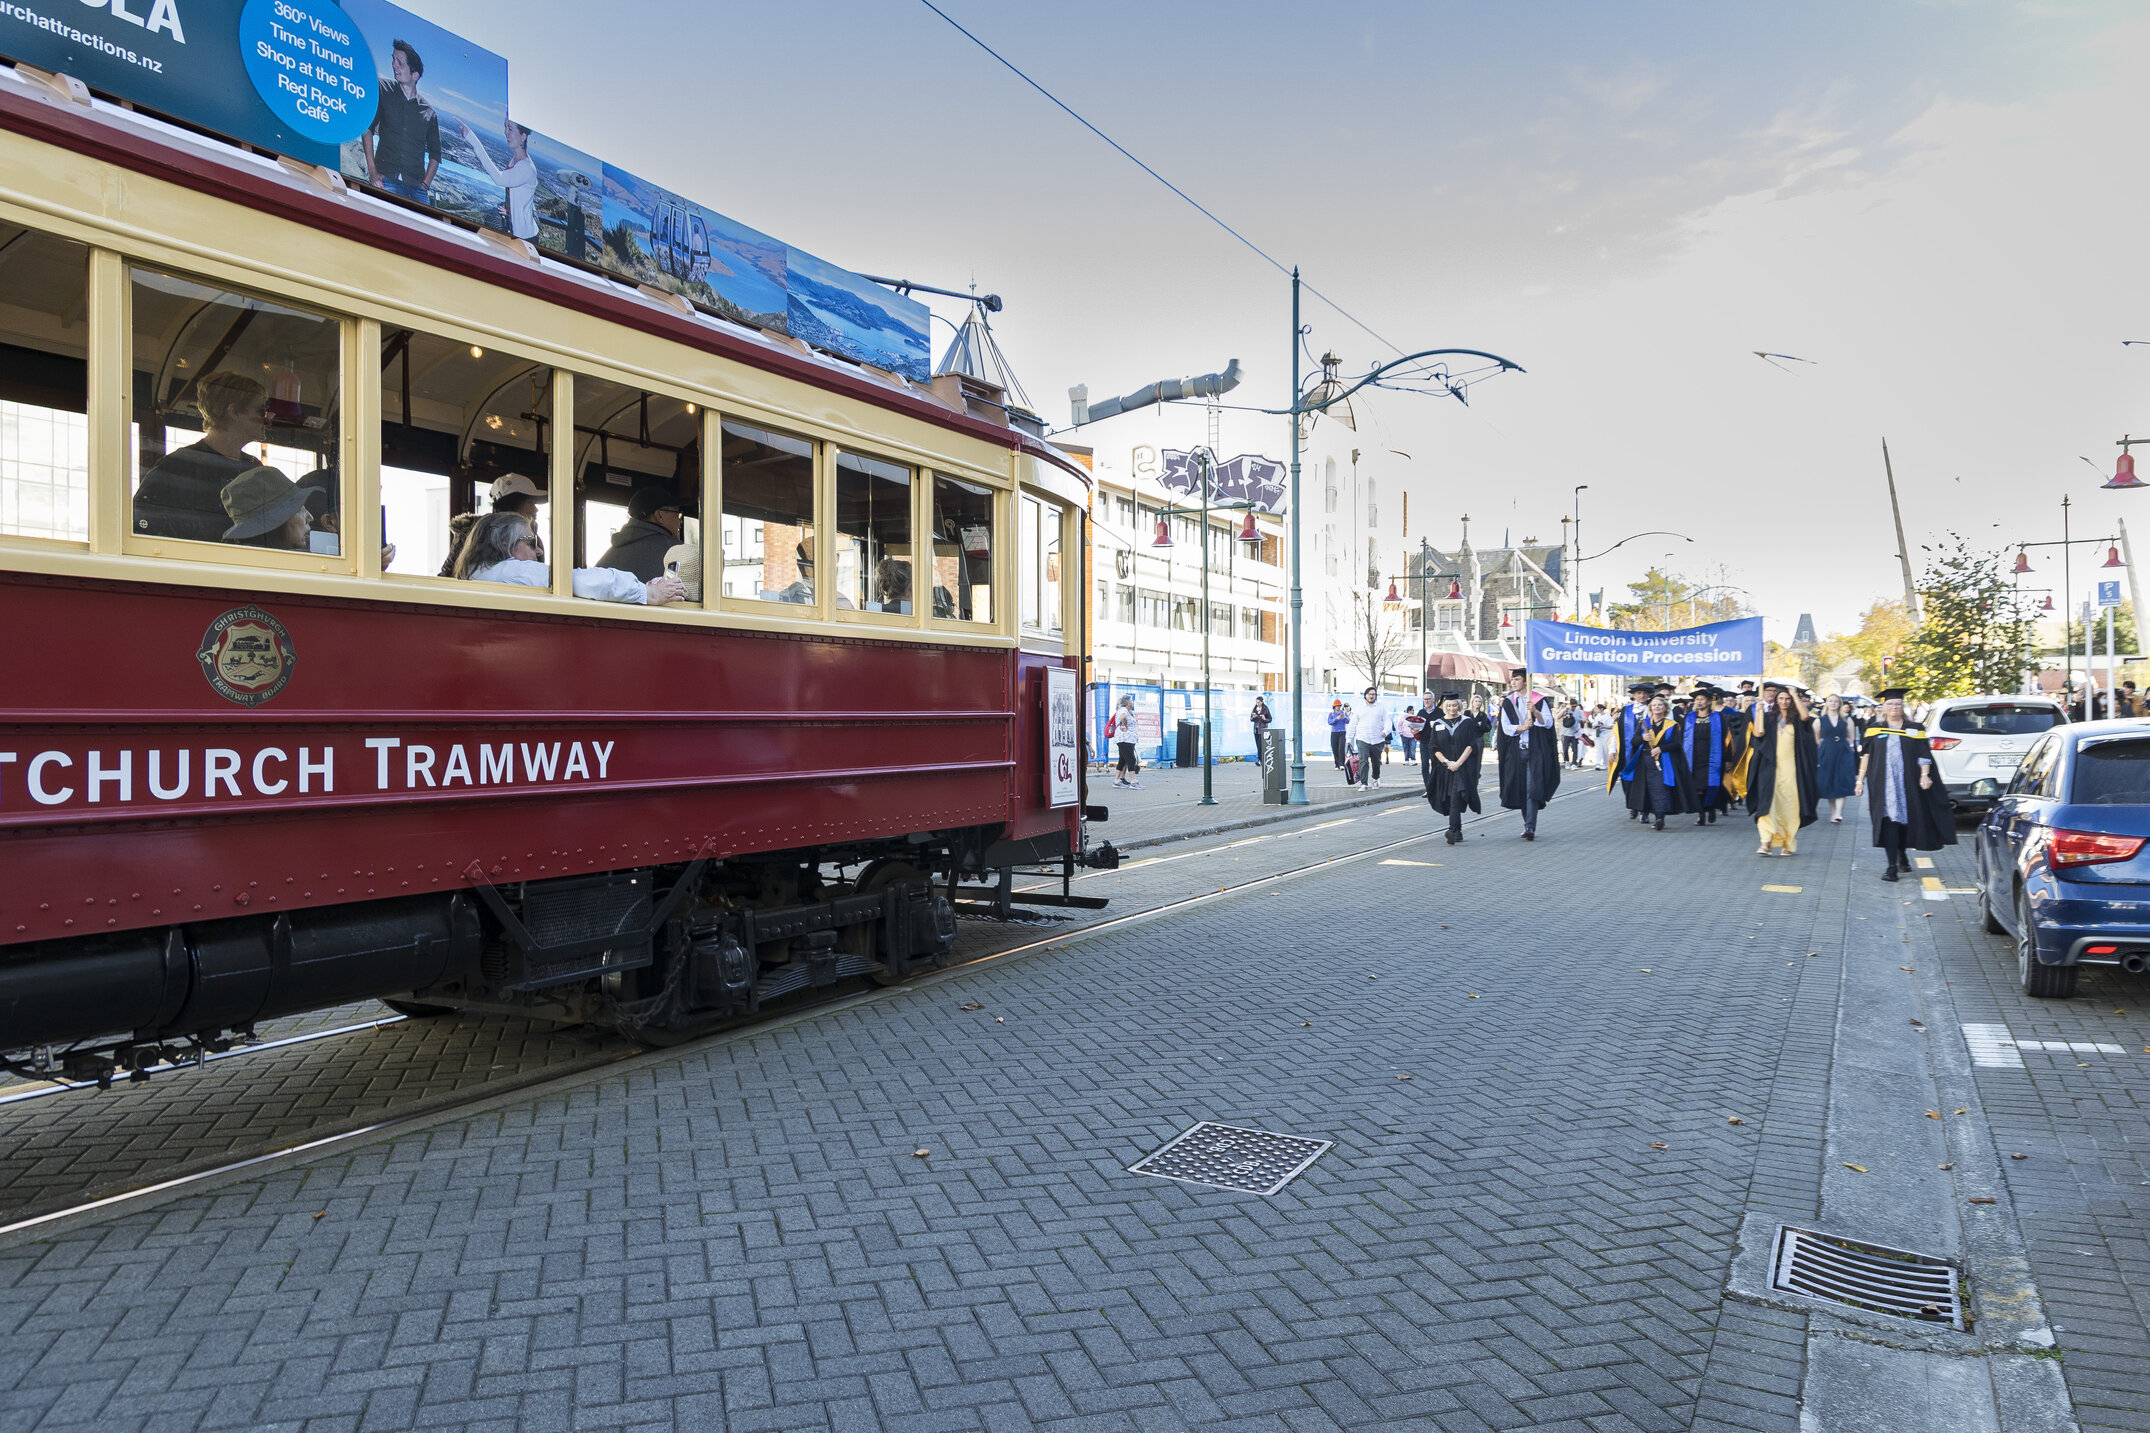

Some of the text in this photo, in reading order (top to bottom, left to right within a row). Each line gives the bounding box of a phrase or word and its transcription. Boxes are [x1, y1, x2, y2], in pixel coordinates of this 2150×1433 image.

[270, 21, 353, 71] Time Tunnel
[309, 15, 350, 46] Views
[257, 40, 366, 100] Shop at the Top
[278, 73, 347, 114] Red Rock
[296, 98, 330, 123] Café
[1564, 631, 1718, 648] Lincoln University
[1541, 647, 1742, 664] Graduation Procession
[212, 675, 287, 702] TRAMWAY BOARD
[365, 737, 615, 790] TRAMWAY
